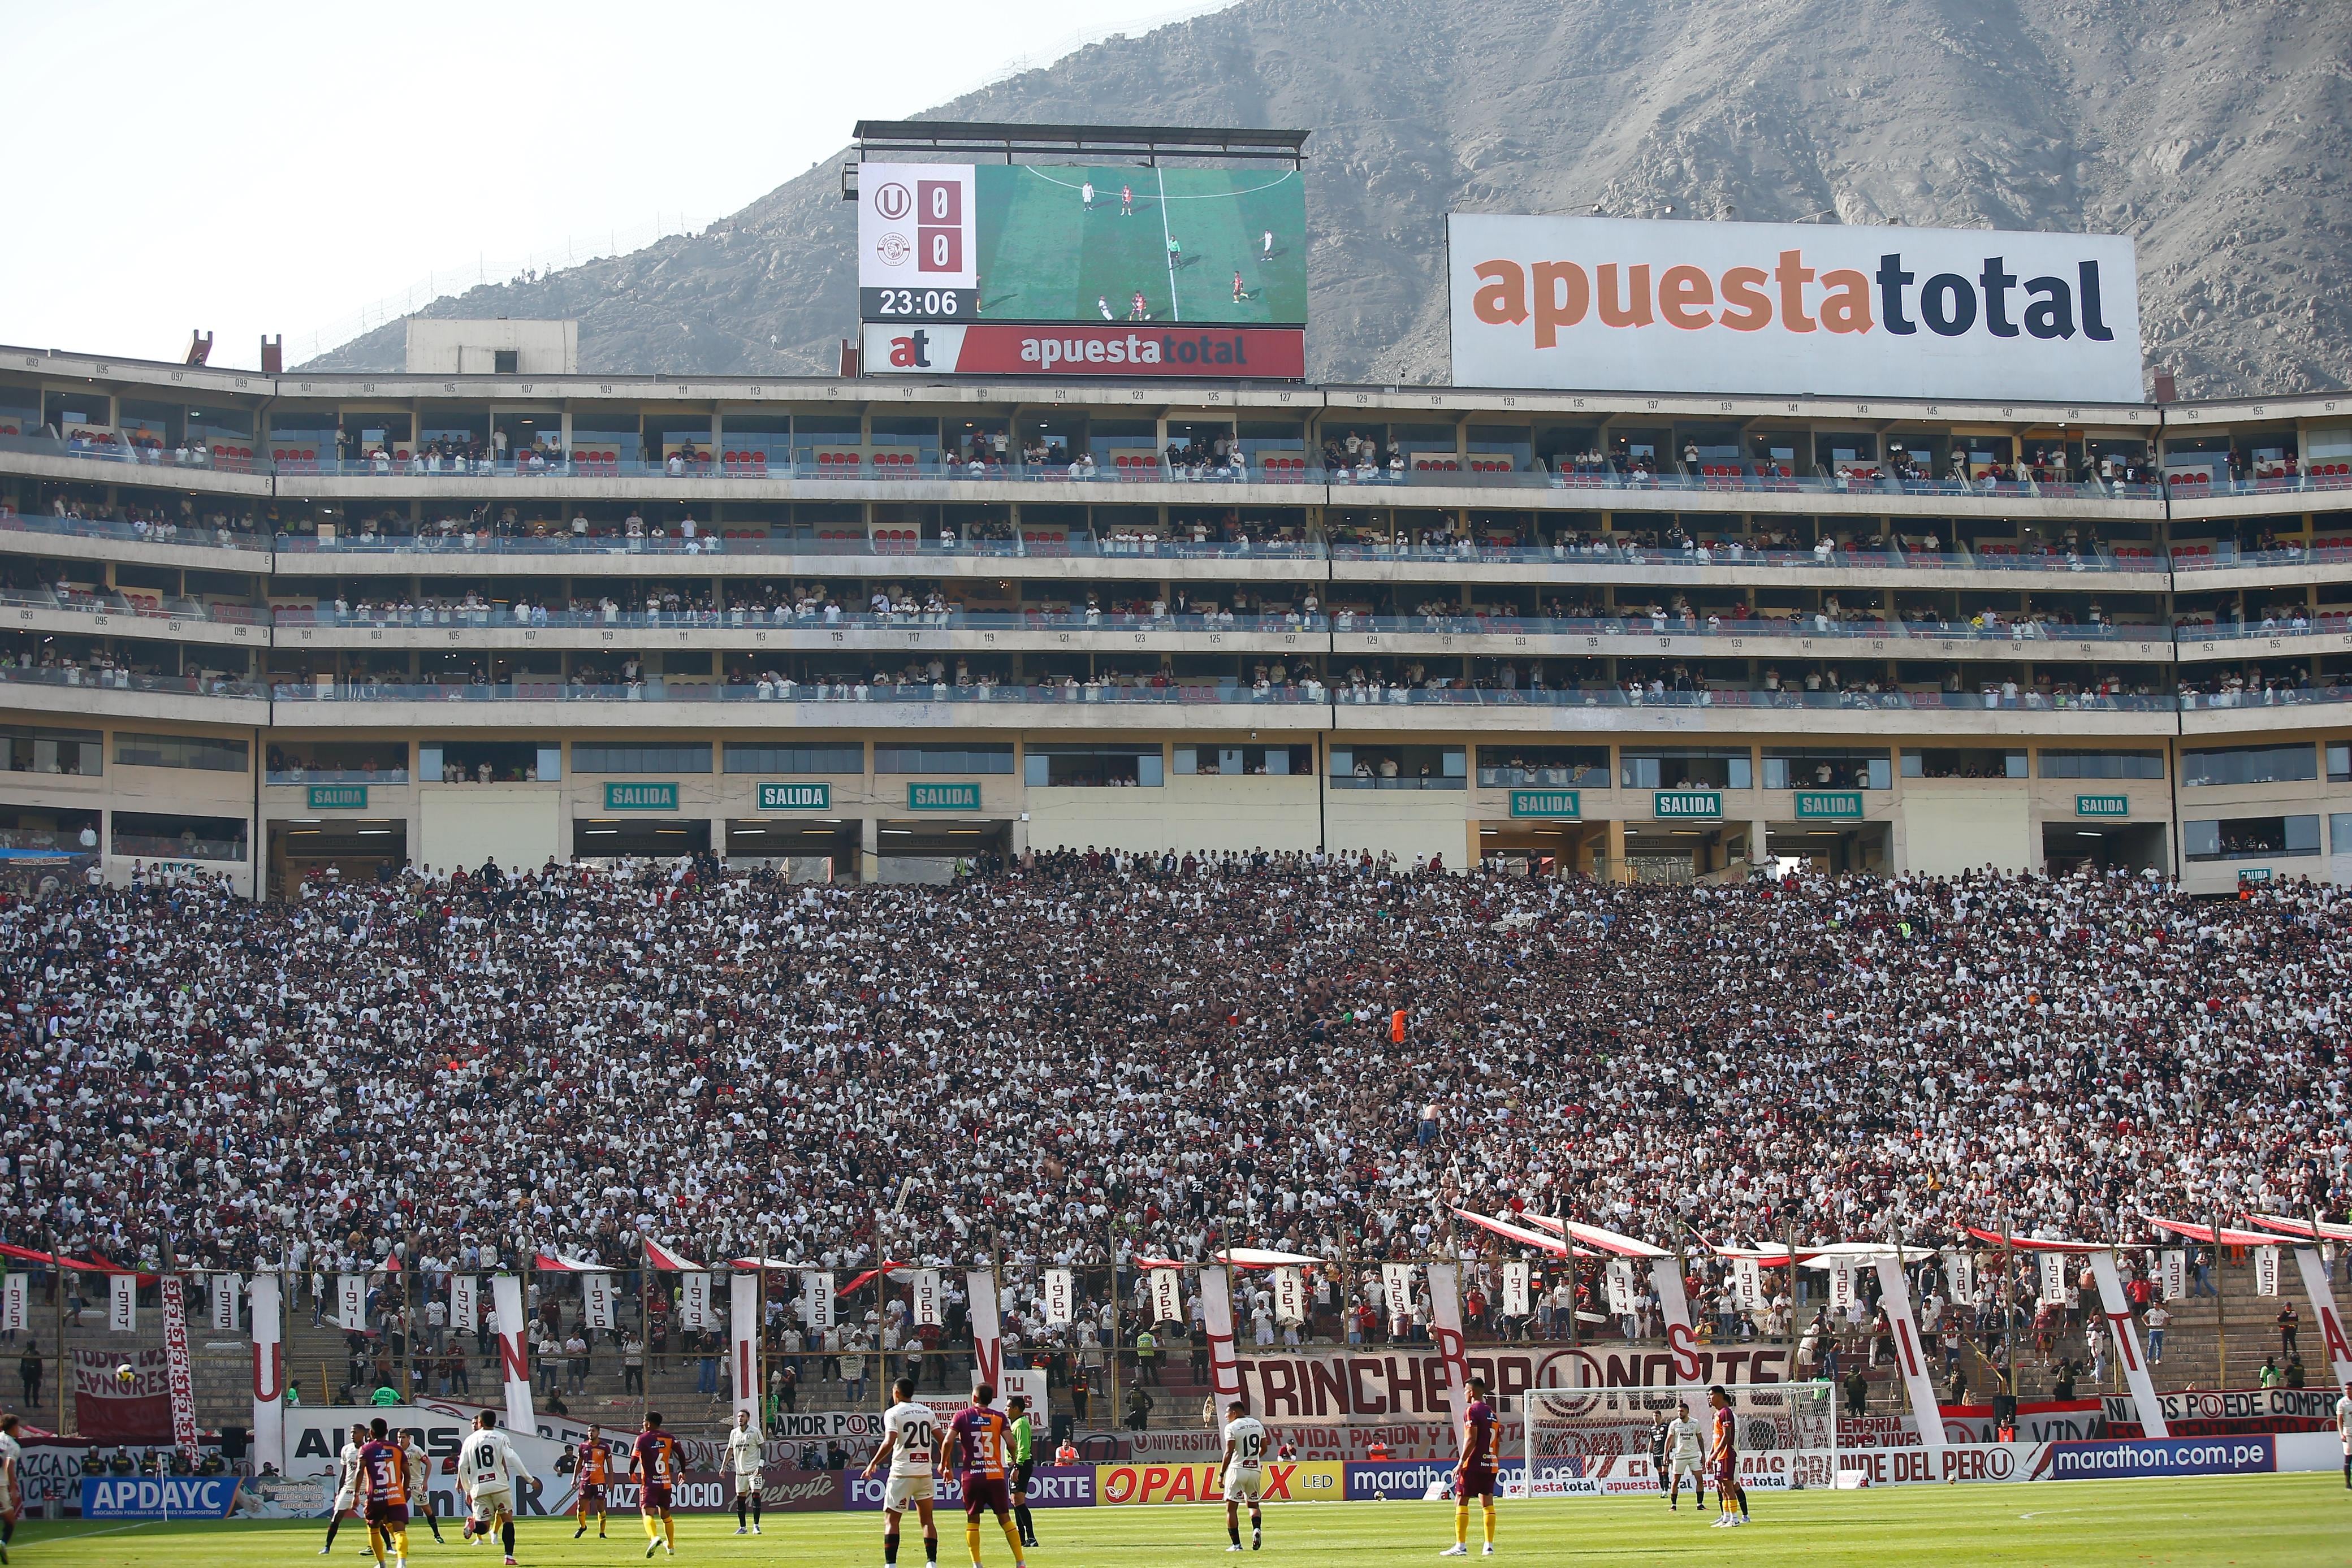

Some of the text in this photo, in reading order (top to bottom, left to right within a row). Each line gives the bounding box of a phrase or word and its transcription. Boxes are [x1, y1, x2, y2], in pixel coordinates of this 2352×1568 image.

[932, 187, 948, 219] 0
[933, 235, 949, 266] 0
[880, 290, 957, 314] 23:06
[1472, 249, 2115, 350] apuestatotal
[889, 329, 931, 368] at
[1021, 334, 1247, 369] apuestatotal
[26, 357, 38, 367] 093
[96, 363, 109, 374] 095
[171, 371, 184, 382] 097
[235, 378, 248, 388] 099
[301, 383, 311, 392] 101
[363, 383, 375, 392] 103
[444, 383, 455, 392] 105
[521, 384, 533, 393] 107
[600, 384, 612, 394] 109
[678, 385, 688, 395] 111
[750, 386, 760, 395] 113
[827, 387, 837, 396] 115
[903, 388, 913, 397] 117
[977, 388, 987, 398] 119
[1055, 389, 1066, 399] 121
[1132, 391, 1144, 400] 123
[1208, 392, 1219, 401] 125
[1280, 392, 1291, 402] 127
[1356, 393, 1367, 404] 129
[1431, 395, 1441, 405] 131
[1503, 397, 1515, 406] 133
[1573, 399, 1584, 408] 135
[1648, 400, 1658, 409] 137
[1721, 402, 1732, 410] 139
[1788, 403, 1798, 412] 141
[1857, 405, 1868, 413] 143
[1927, 406, 1938, 415] 145
[2253, 406, 2264, 415] 155
[2325, 402, 2336, 411] 157
[2002, 408, 2013, 417] 147
[2068, 410, 2079, 419] 149
[2129, 410, 2138, 420] 151
[2187, 410, 2198, 419] 153
[266, 479, 270, 488] F
[265, 555, 269, 564] E
[2163, 575, 2167, 584] E
[20, 610, 33, 620] 093
[263, 629, 267, 638] D
[2168, 644, 2172, 653] D
[315, 791, 361, 803] SALIDA
[613, 788, 671, 804] SALIDA
[766, 789, 823, 805] SALIDA
[916, 789, 974, 804] SALIDA
[1518, 796, 1573, 812] SALIDA
[1661, 797, 1716, 813] SALIDA
[1802, 798, 1856, 813] SALIDA
[2082, 799, 2124, 812] SALIDA
[1192, 1184, 1203, 1193] 22
[2105, 1397, 2127, 1421] NI
[775, 1415, 827, 1435] AMOR
[903, 1420, 931, 1449] 20
[1292, 1429, 1341, 1448] VIDA
[1427, 1426, 1438, 1446] Y
[971, 1431, 995, 1458] 33
[1243, 1434, 1260, 1457] 19
[475, 1445, 494, 1469] 18
[2058, 1445, 2264, 1470] marathon.com.pe
[655, 1453, 665, 1474] 6
[1894, 1451, 1936, 1481] DEL
[374, 1461, 397, 1485] 31
[299, 1484, 317, 1492] letra
[1104, 1466, 1333, 1504] OPALX LED
[93, 1481, 221, 1509] APDAYC
[1441, 1490, 1451, 1500] at
